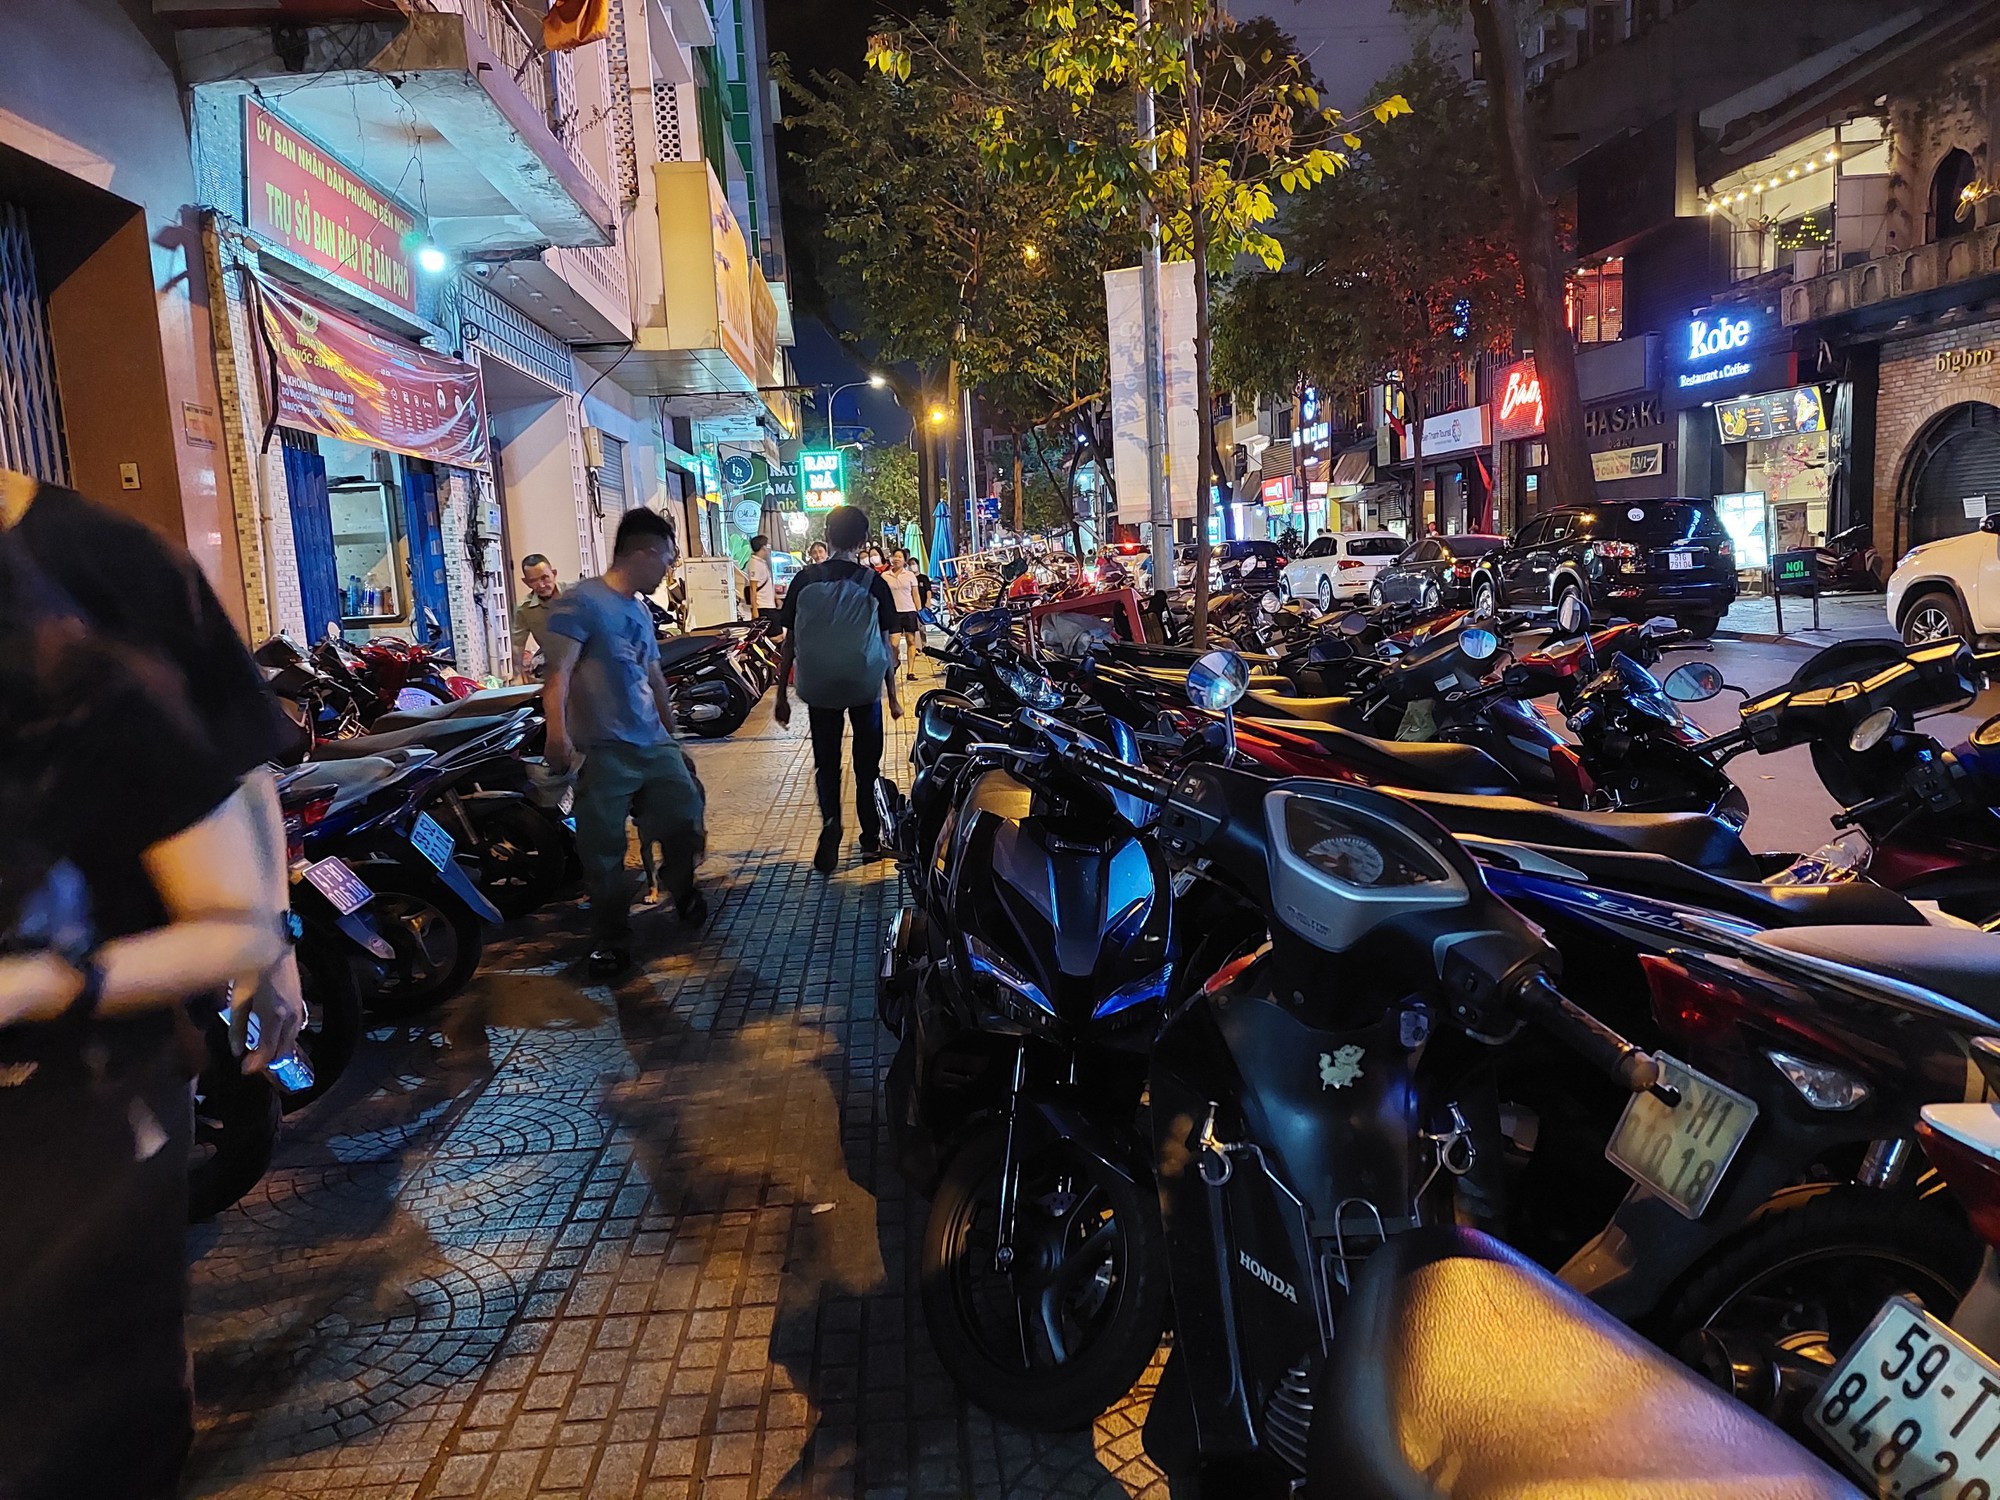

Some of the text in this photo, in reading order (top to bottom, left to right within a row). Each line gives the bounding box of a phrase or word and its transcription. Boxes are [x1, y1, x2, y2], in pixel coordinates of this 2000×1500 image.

[274, 129, 296, 163] BAN
[298, 147, 325, 182] NHÂN
[327, 167, 345, 196] DÂN
[346, 181, 378, 220] PHƯỜNG
[265, 181, 292, 246] TRỤ
[294, 189, 311, 246] SỞ
[313, 210, 335, 260] BAN
[338, 215, 358, 272] BẢO
[359, 236, 373, 290] VỆ
[374, 244, 392, 292] DÂN
[1688, 317, 1749, 360] Kobe
[1935, 348, 1992, 373] bigbro
[1680, 369, 1718, 387] Restaurant
[1724, 362, 1750, 377] Coffee
[1584, 399, 1662, 436] HASAKI
[803, 455, 838, 471] RAU
[775, 480, 796, 495] MÁ
[809, 471, 836, 489] MÁ
[1674, 553, 1687, 561] 51G
[1786, 560, 1803, 571] NƠI
[1240, 1249, 1298, 1304] HONDA
